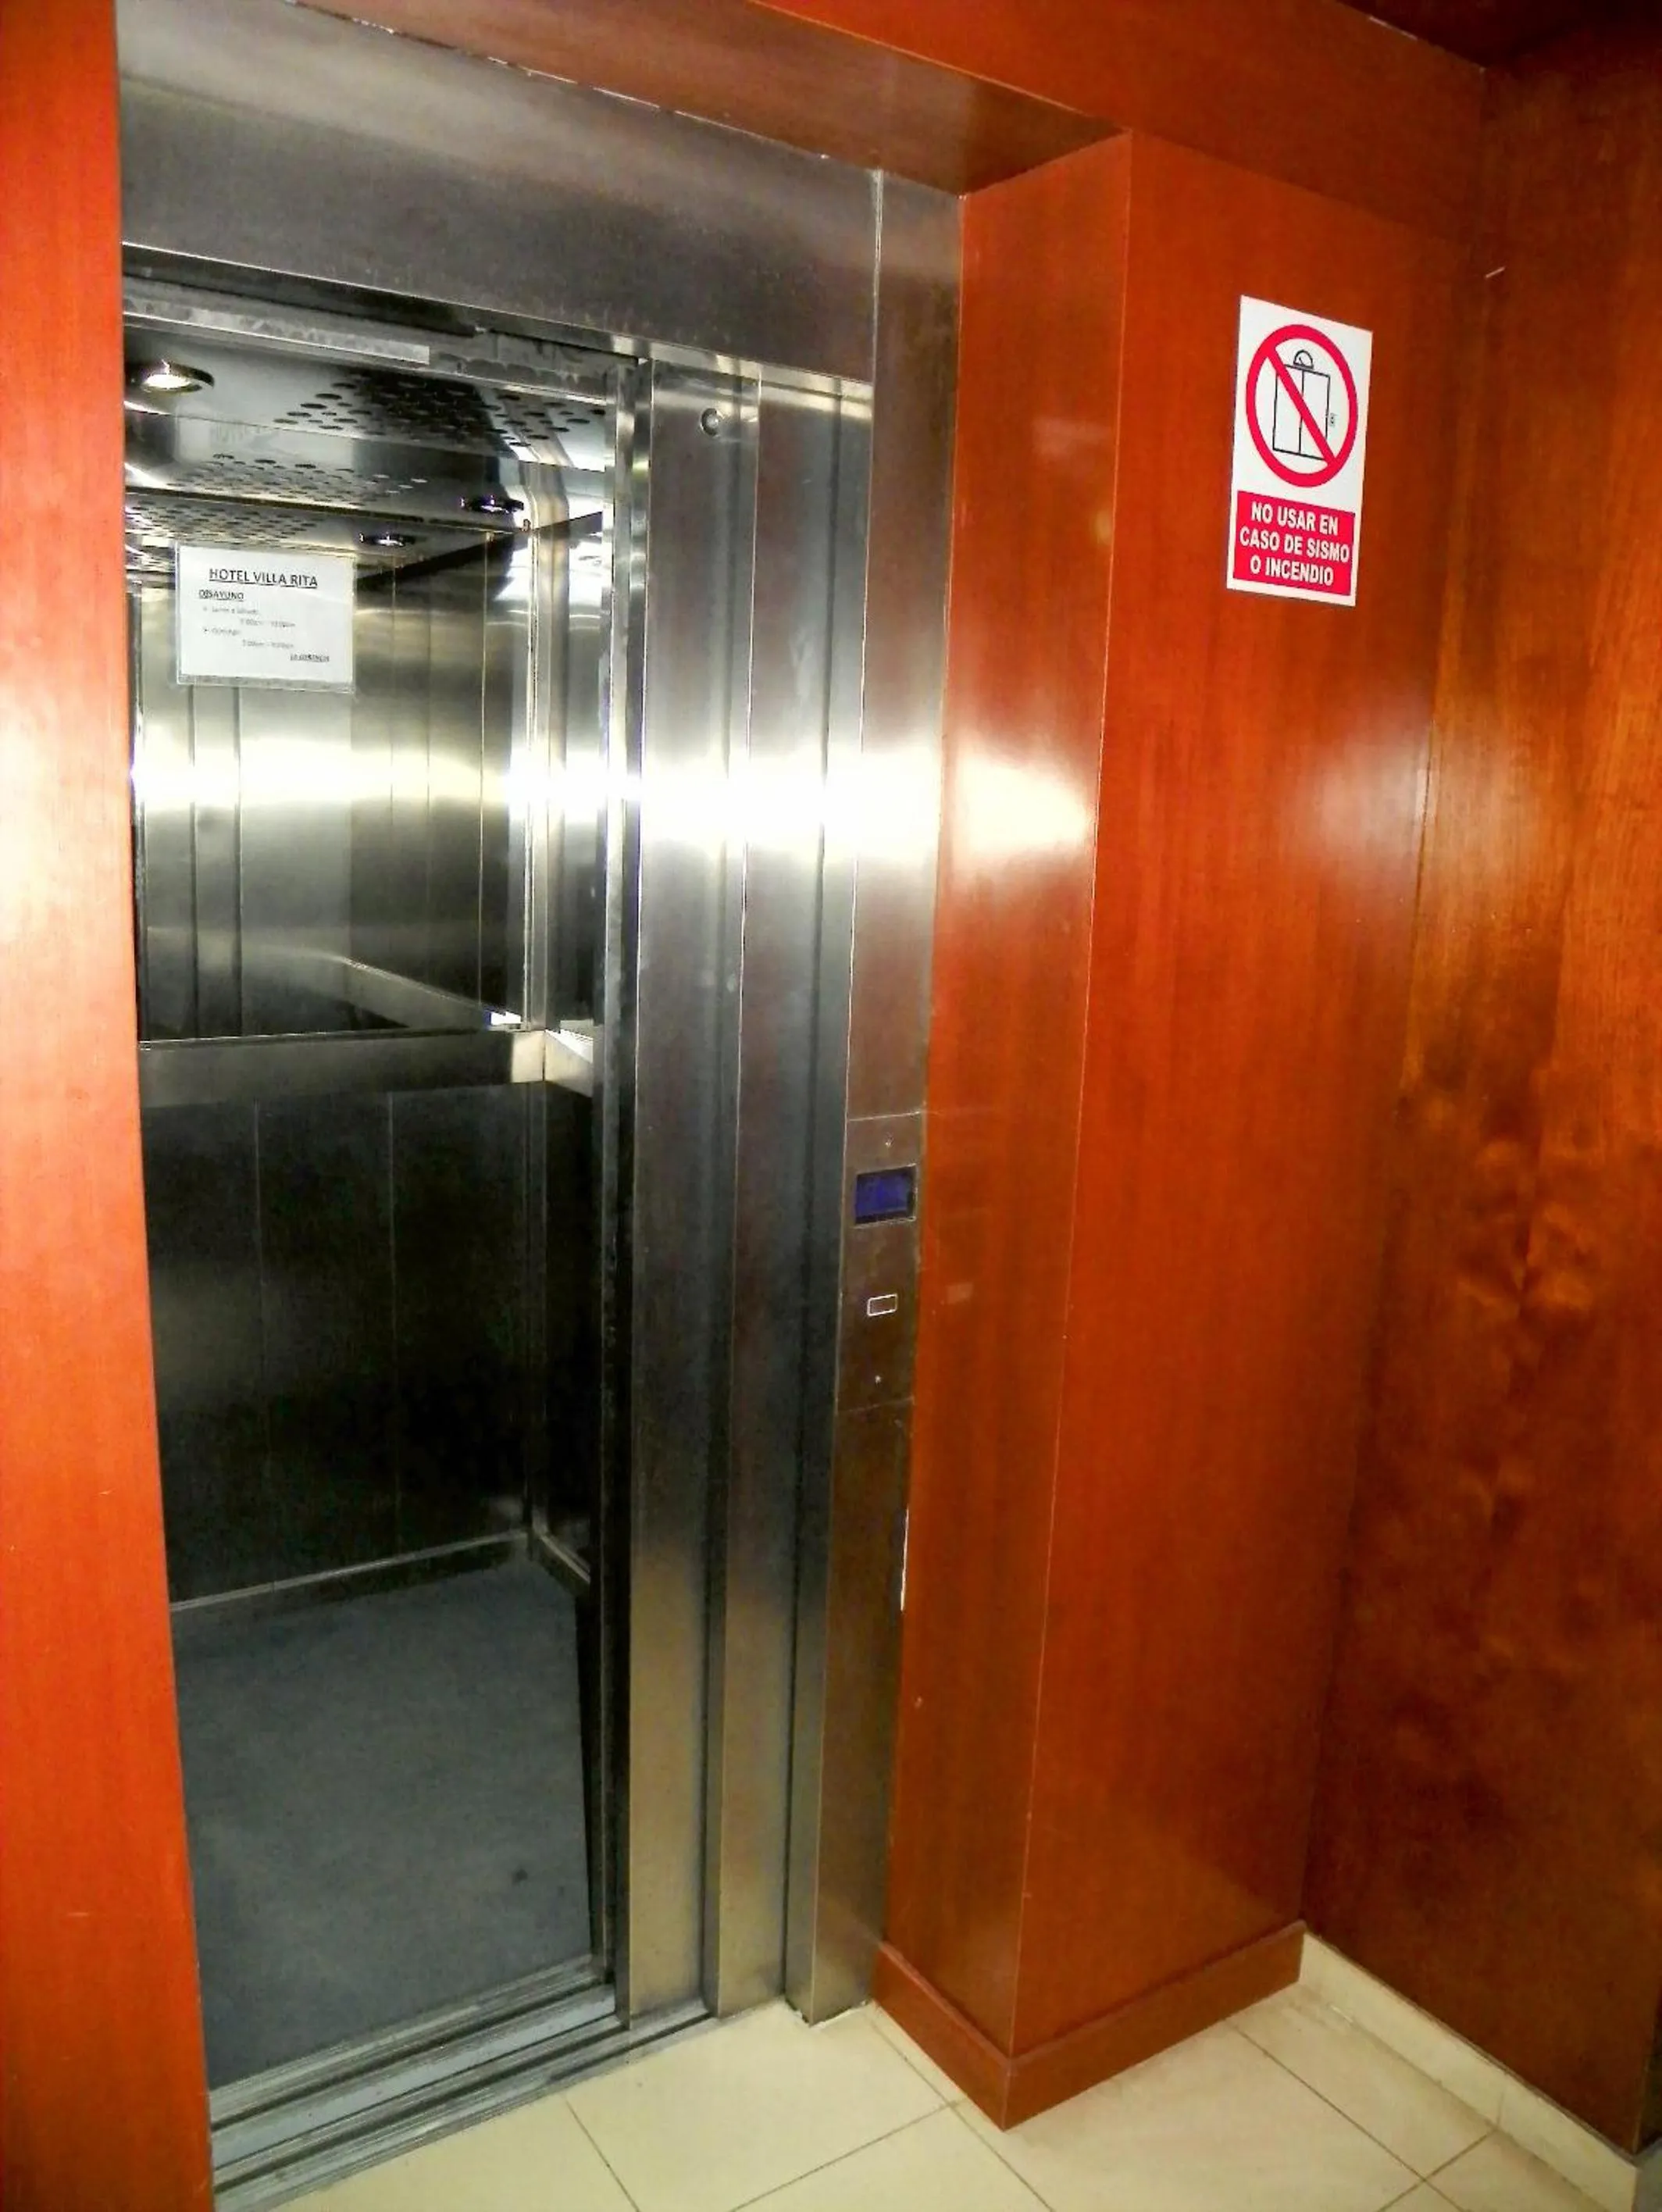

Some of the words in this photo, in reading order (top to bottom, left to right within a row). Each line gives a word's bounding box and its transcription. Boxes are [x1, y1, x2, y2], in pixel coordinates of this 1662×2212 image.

[1251, 501, 1274, 524] NO
[1277, 505, 1316, 532] USAR
[1319, 514, 1339, 536] EN
[1239, 526, 1280, 551] CASO
[1284, 533, 1303, 555] DE
[1306, 537, 1350, 563] SISMO
[209, 569, 250, 583] HOTEL
[253, 571, 287, 585] VILLA
[291, 574, 318, 587] RITA
[1250, 555, 1261, 574] O
[1265, 557, 1334, 586] INCENDIO
